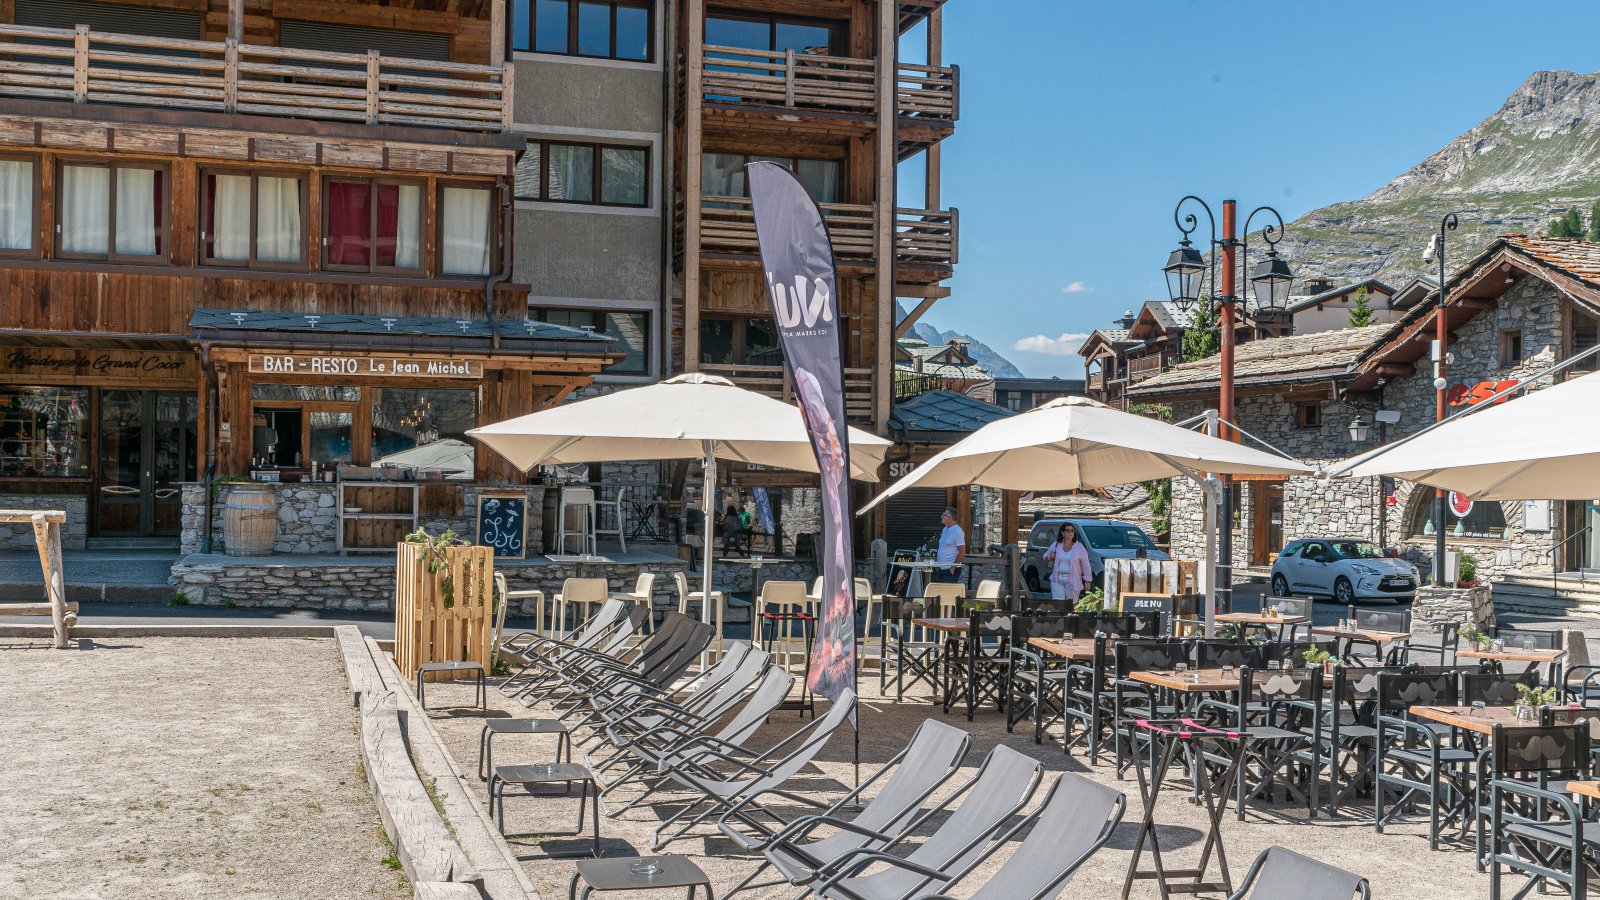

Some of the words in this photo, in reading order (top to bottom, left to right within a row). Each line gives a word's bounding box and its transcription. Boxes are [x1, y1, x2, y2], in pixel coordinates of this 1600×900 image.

[76, 355, 91, 368] le
[92, 355, 142, 372] Grand
[263, 356, 294, 373] BAR
[311, 357, 358, 374] RESTO
[369, 358, 385, 373] Le
[391, 359, 420, 376] Jean
[427, 360, 470, 376] Michel
[1134, 599, 1162, 608] MENU
